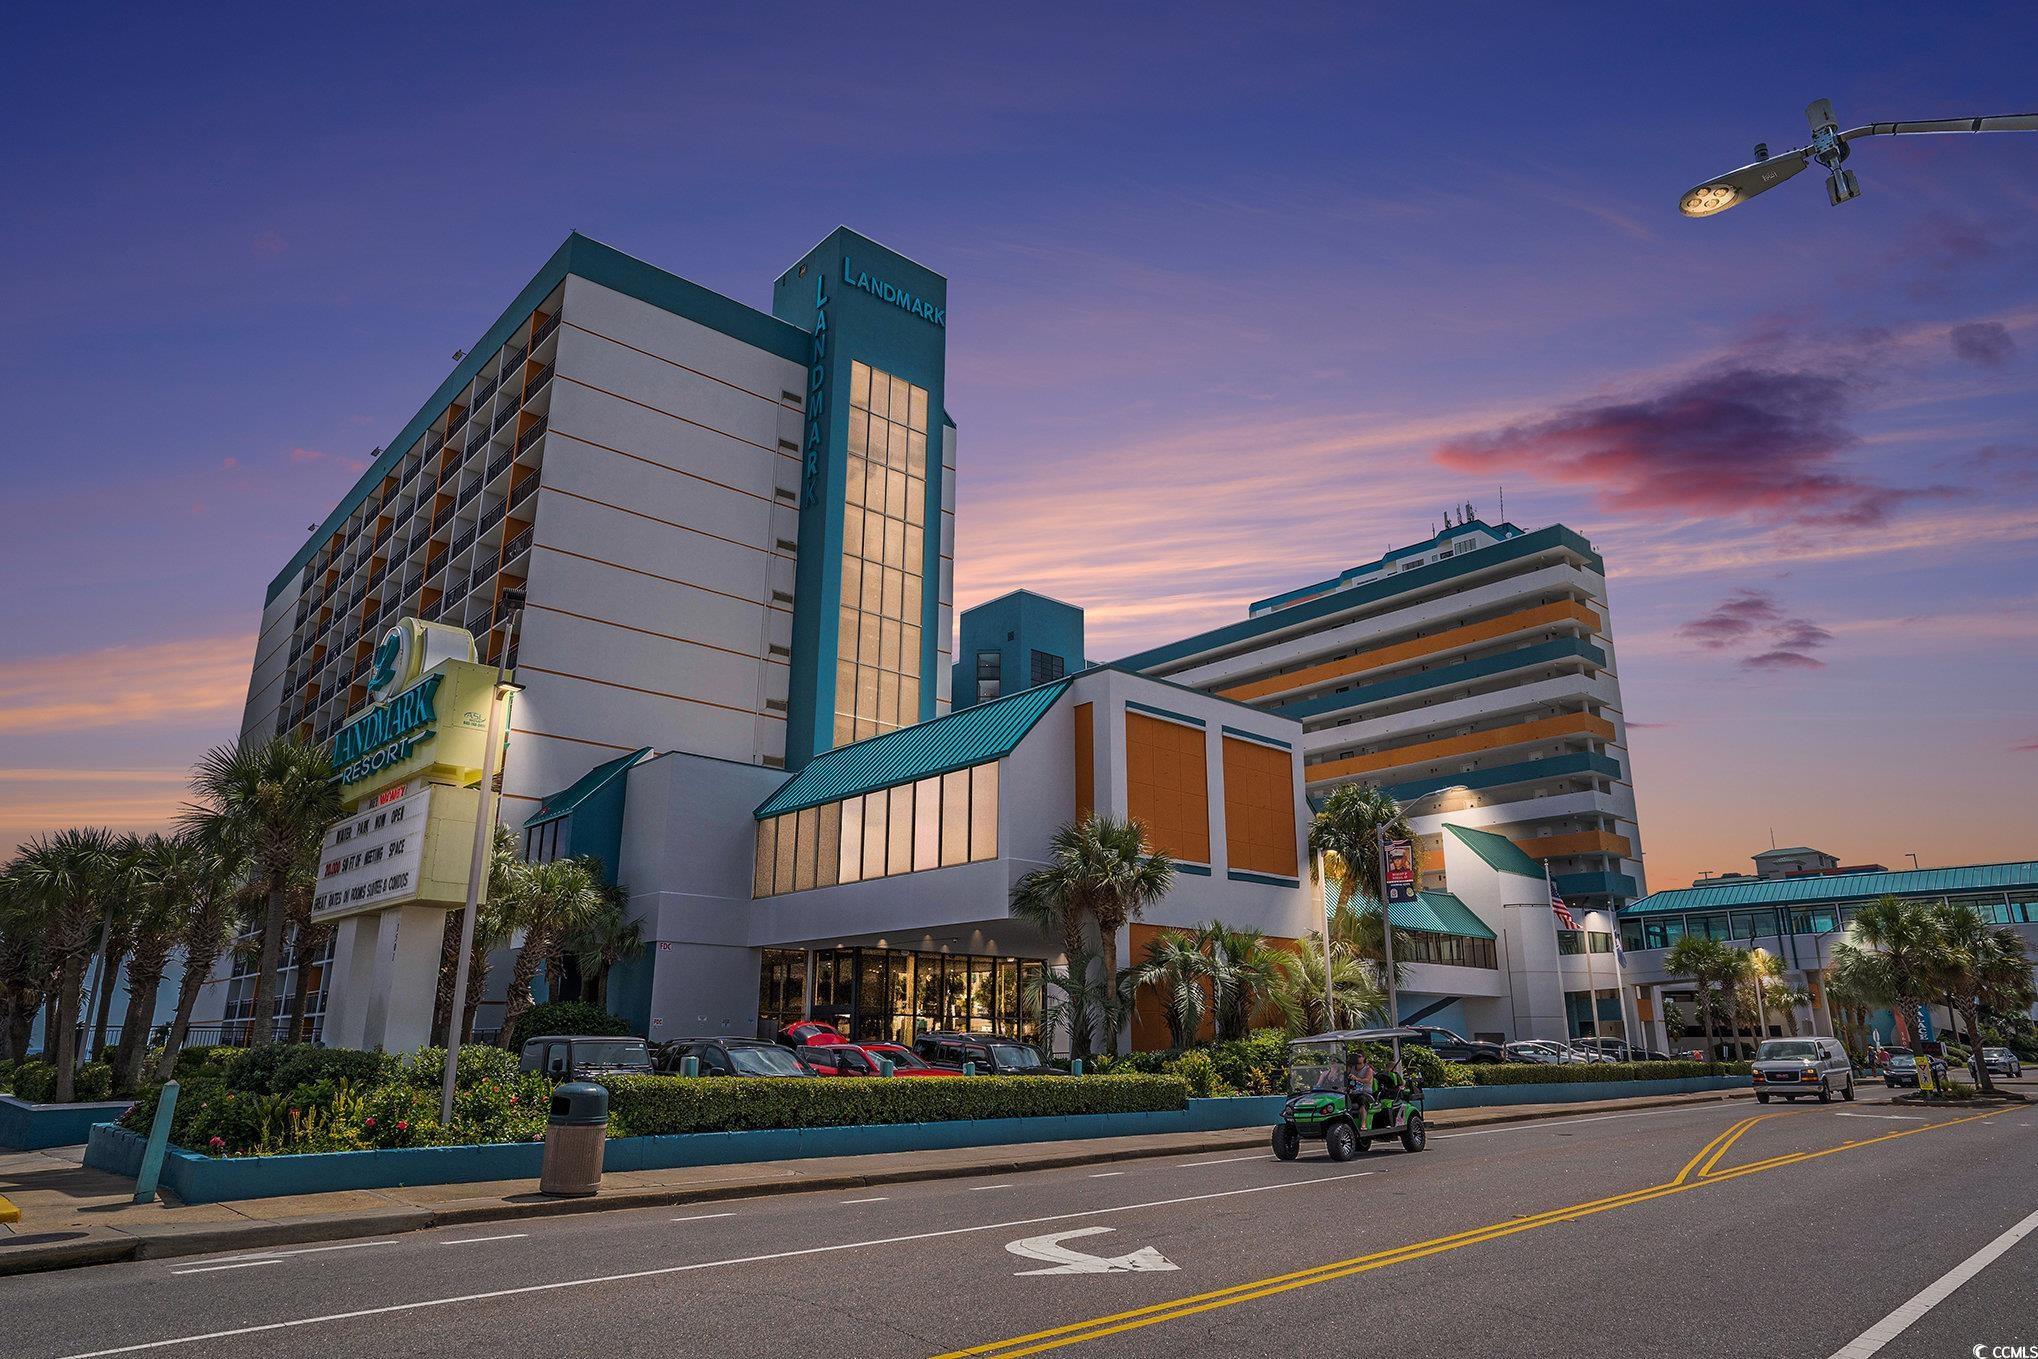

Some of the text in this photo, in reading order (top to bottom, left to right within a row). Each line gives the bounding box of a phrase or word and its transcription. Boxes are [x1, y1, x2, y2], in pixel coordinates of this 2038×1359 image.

[844, 256, 946, 328] LANDMARK
[804, 272, 828, 510] LANDMARK
[332, 679, 434, 768] LANDMARK
[342, 737, 409, 785] RESORT
[336, 826, 352, 844] WATER
[356, 818, 370, 836] PARK
[391, 804, 405, 824] OPEN
[363, 845, 383, 866] MEETING
[388, 838, 406, 858] SPACE
[388, 872, 409, 892] CONDOS
